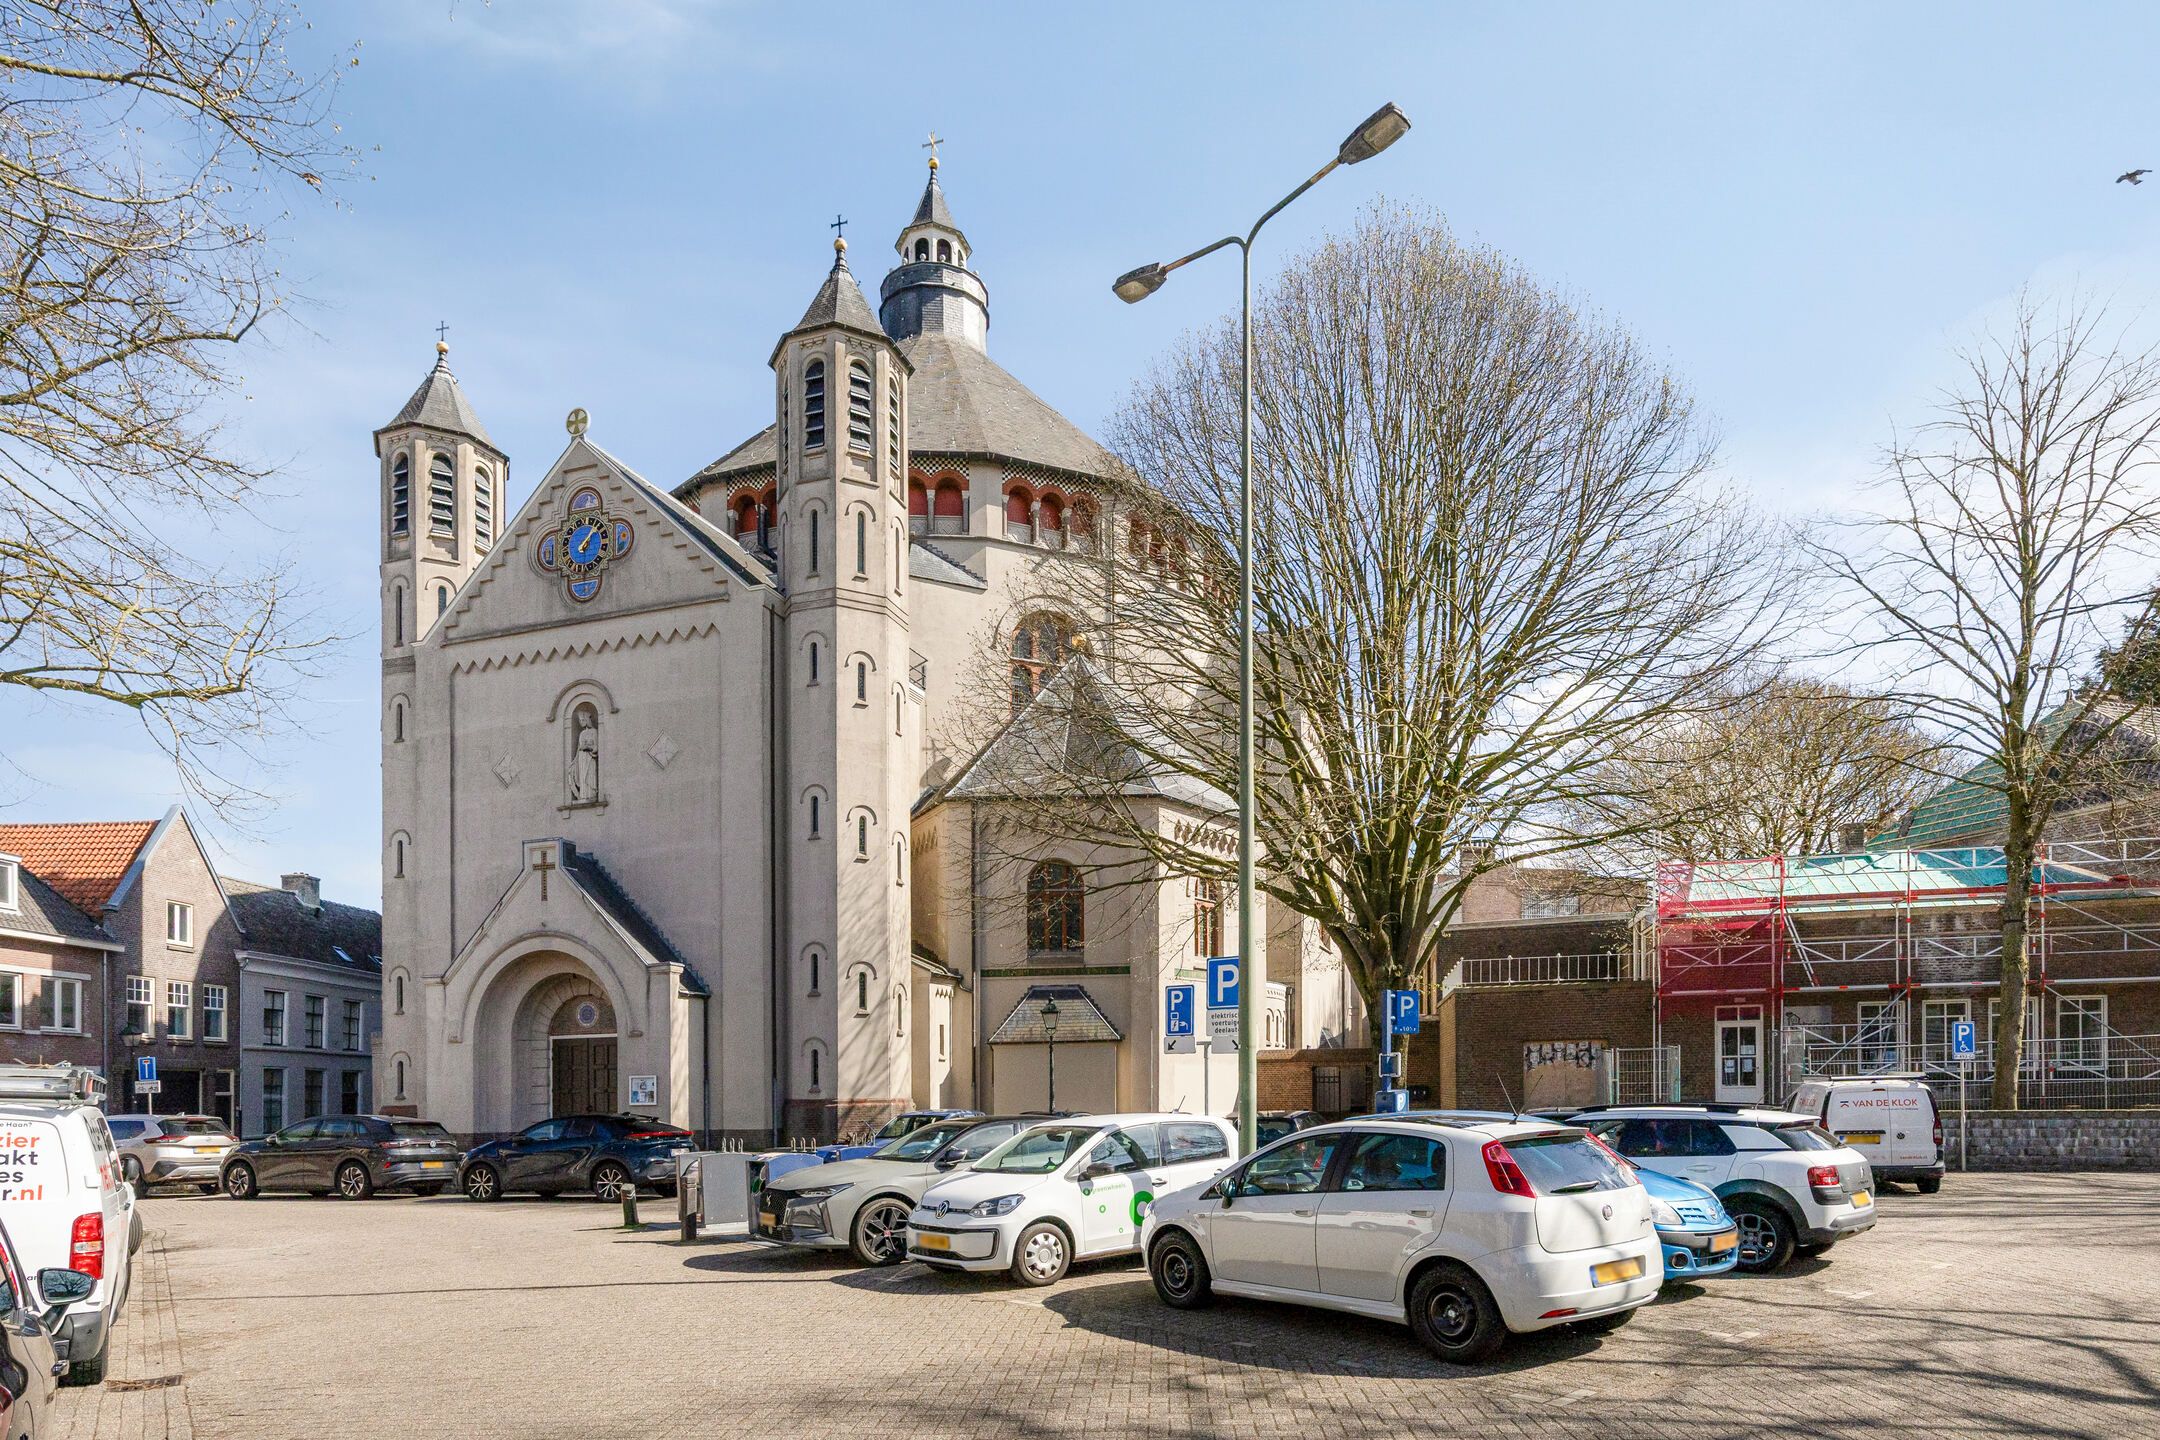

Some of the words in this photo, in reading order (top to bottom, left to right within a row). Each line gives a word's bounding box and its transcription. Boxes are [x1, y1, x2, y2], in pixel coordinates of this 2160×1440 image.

[1218, 964, 1239, 1002] P
[1171, 990, 1183, 1011] P
[1401, 995, 1414, 1017] P
[1958, 1025, 1970, 1041] P
